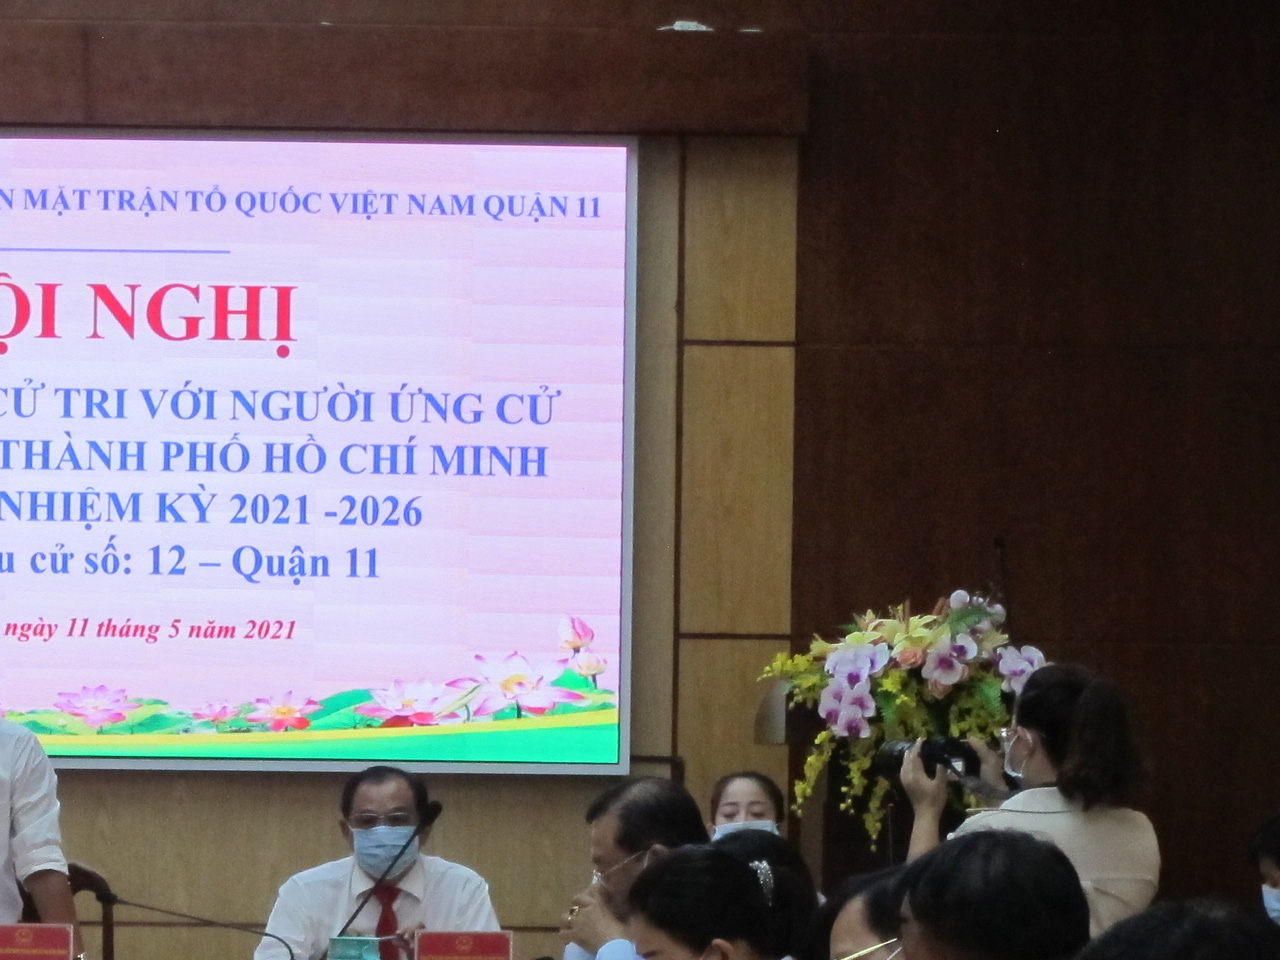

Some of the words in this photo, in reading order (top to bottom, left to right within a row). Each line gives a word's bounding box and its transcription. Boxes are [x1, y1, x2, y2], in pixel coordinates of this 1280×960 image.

[23, 186, 91, 216] MẶT
[97, 187, 179, 217] TRẬN
[235, 186, 322, 217] QUỐC
[329, 189, 398, 220] VIỆT
[407, 193, 475, 215] NAM
[483, 191, 568, 223] QUẬN
[577, 195, 601, 218] 11
[86, 283, 298, 358] NGHỊ
[54, 388, 127, 419] TRI
[139, 380, 217, 421] VỚI
[229, 382, 375, 422] NGƯỜI
[388, 383, 484, 424] ỨNG
[496, 385, 562, 425] CỬ
[160, 433, 250, 473] PHỐ
[262, 434, 327, 474] HỒ
[339, 435, 418, 475] CHÍ
[430, 445, 548, 477] MINH
[155, 484, 219, 524] KỲ
[228, 493, 311, 525] 2021
[30, 543, 74, 574] cử
[83, 535, 131, 574] số:
[148, 545, 187, 575] 12
[232, 545, 331, 585] Quận
[345, 546, 380, 578] 11
[4, 617, 58, 642] ngày
[66, 618, 89, 637] 11
[96, 618, 160, 643] tháng
[167, 619, 181, 639] 5
[188, 619, 237, 640] năm
[243, 620, 297, 640] 2021
